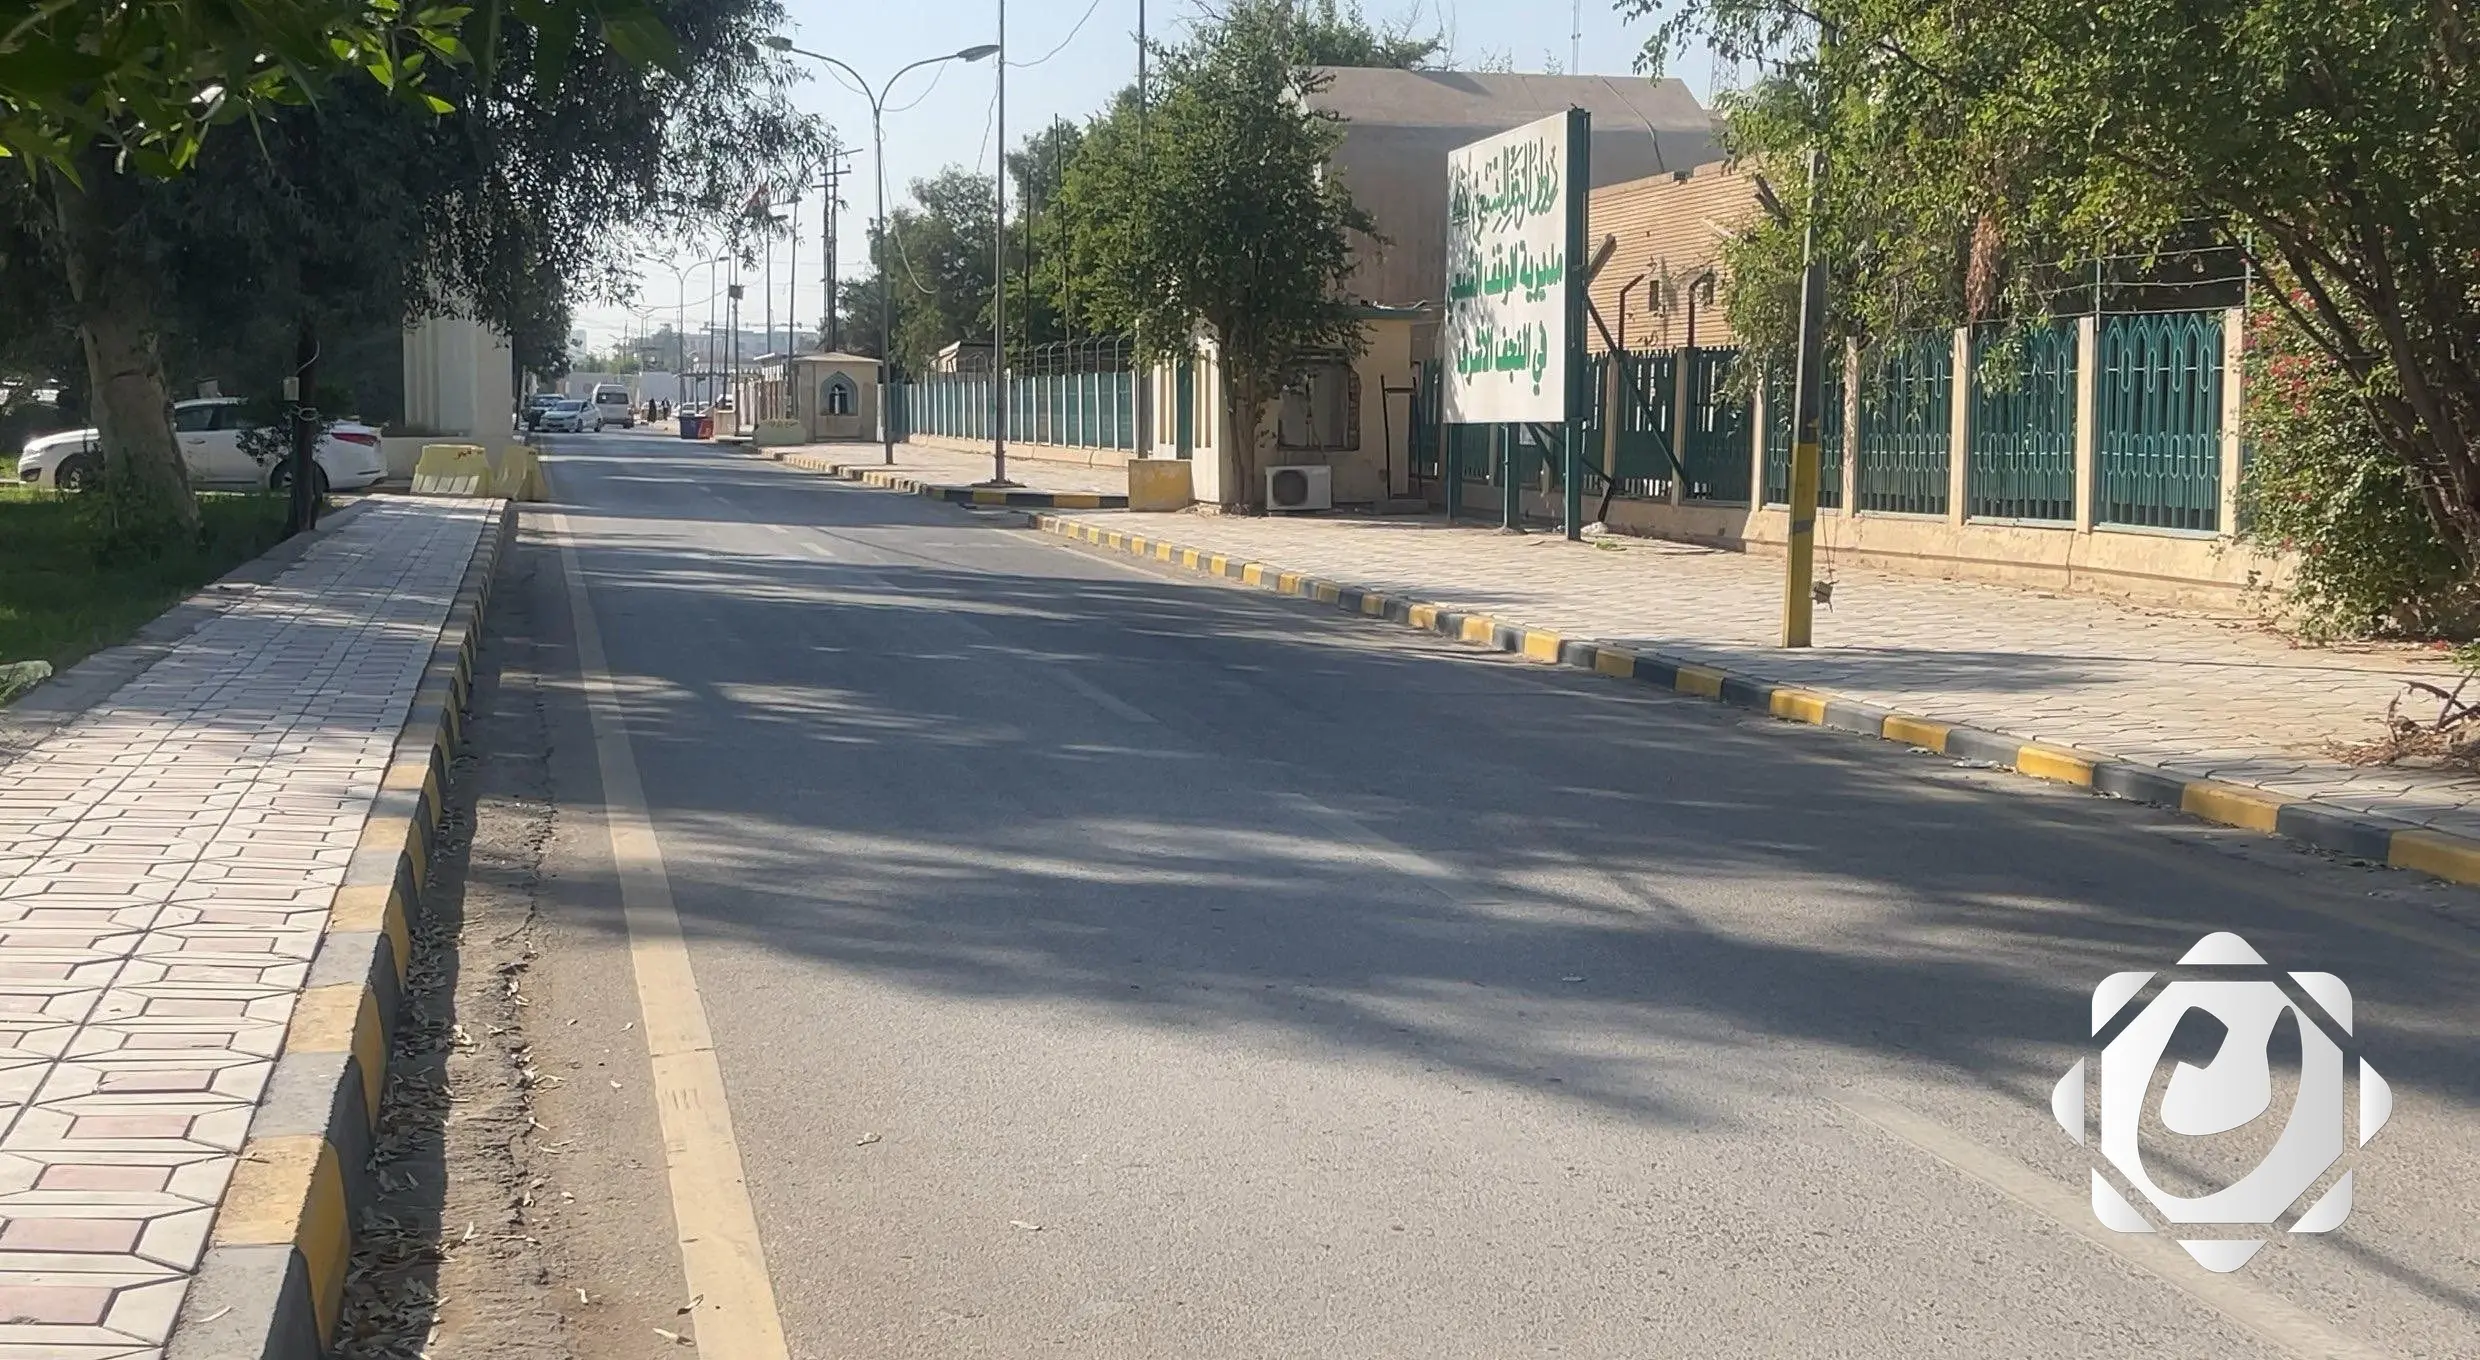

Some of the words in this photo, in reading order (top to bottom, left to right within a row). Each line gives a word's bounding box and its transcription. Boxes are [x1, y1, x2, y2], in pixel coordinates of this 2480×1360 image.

[1471, 145, 1508, 246] الشيعي
[1501, 140, 1531, 230] الوقف
[1528, 137, 1558, 216] ديوان
[1447, 246, 1483, 326] الشيعي
[1485, 242, 1518, 305] الوقف
[1520, 240, 1563, 303] مديرية
[1495, 322, 1531, 384] النجف
[1532, 320, 1548, 397] في
